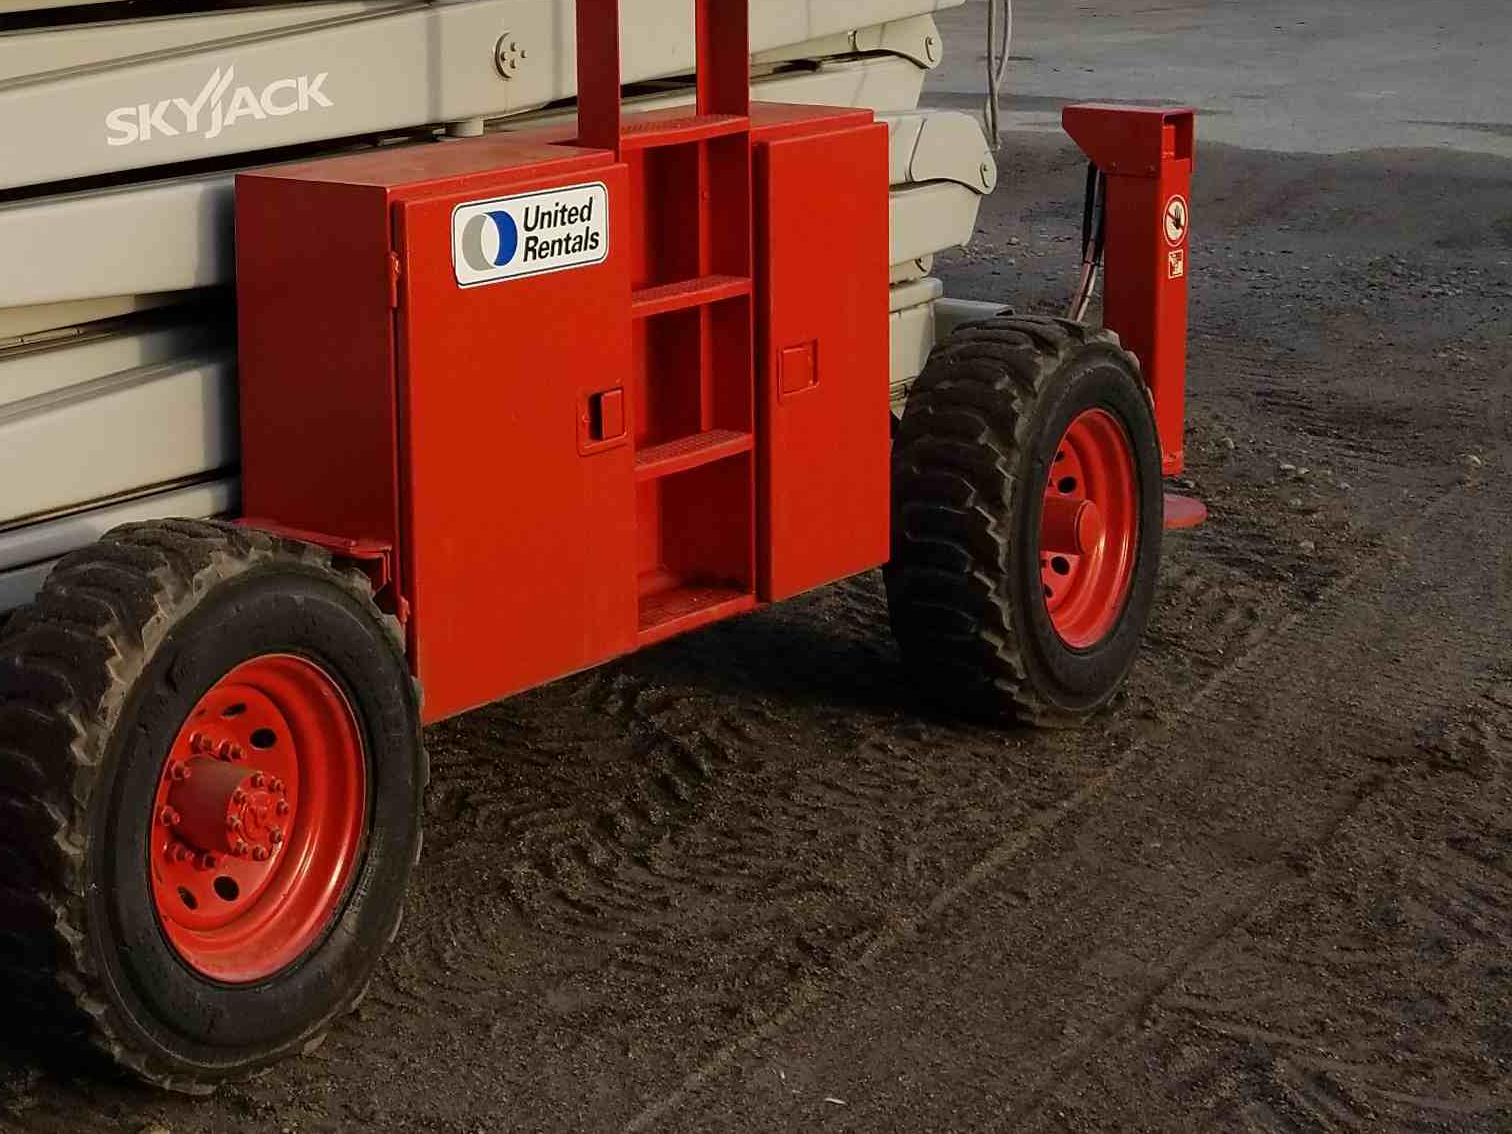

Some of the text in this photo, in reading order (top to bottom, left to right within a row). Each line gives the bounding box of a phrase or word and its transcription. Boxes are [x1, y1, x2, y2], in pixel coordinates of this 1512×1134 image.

[104, 65, 335, 147] SKYJACK
[523, 196, 593, 232] United
[523, 226, 599, 263] Rentals
